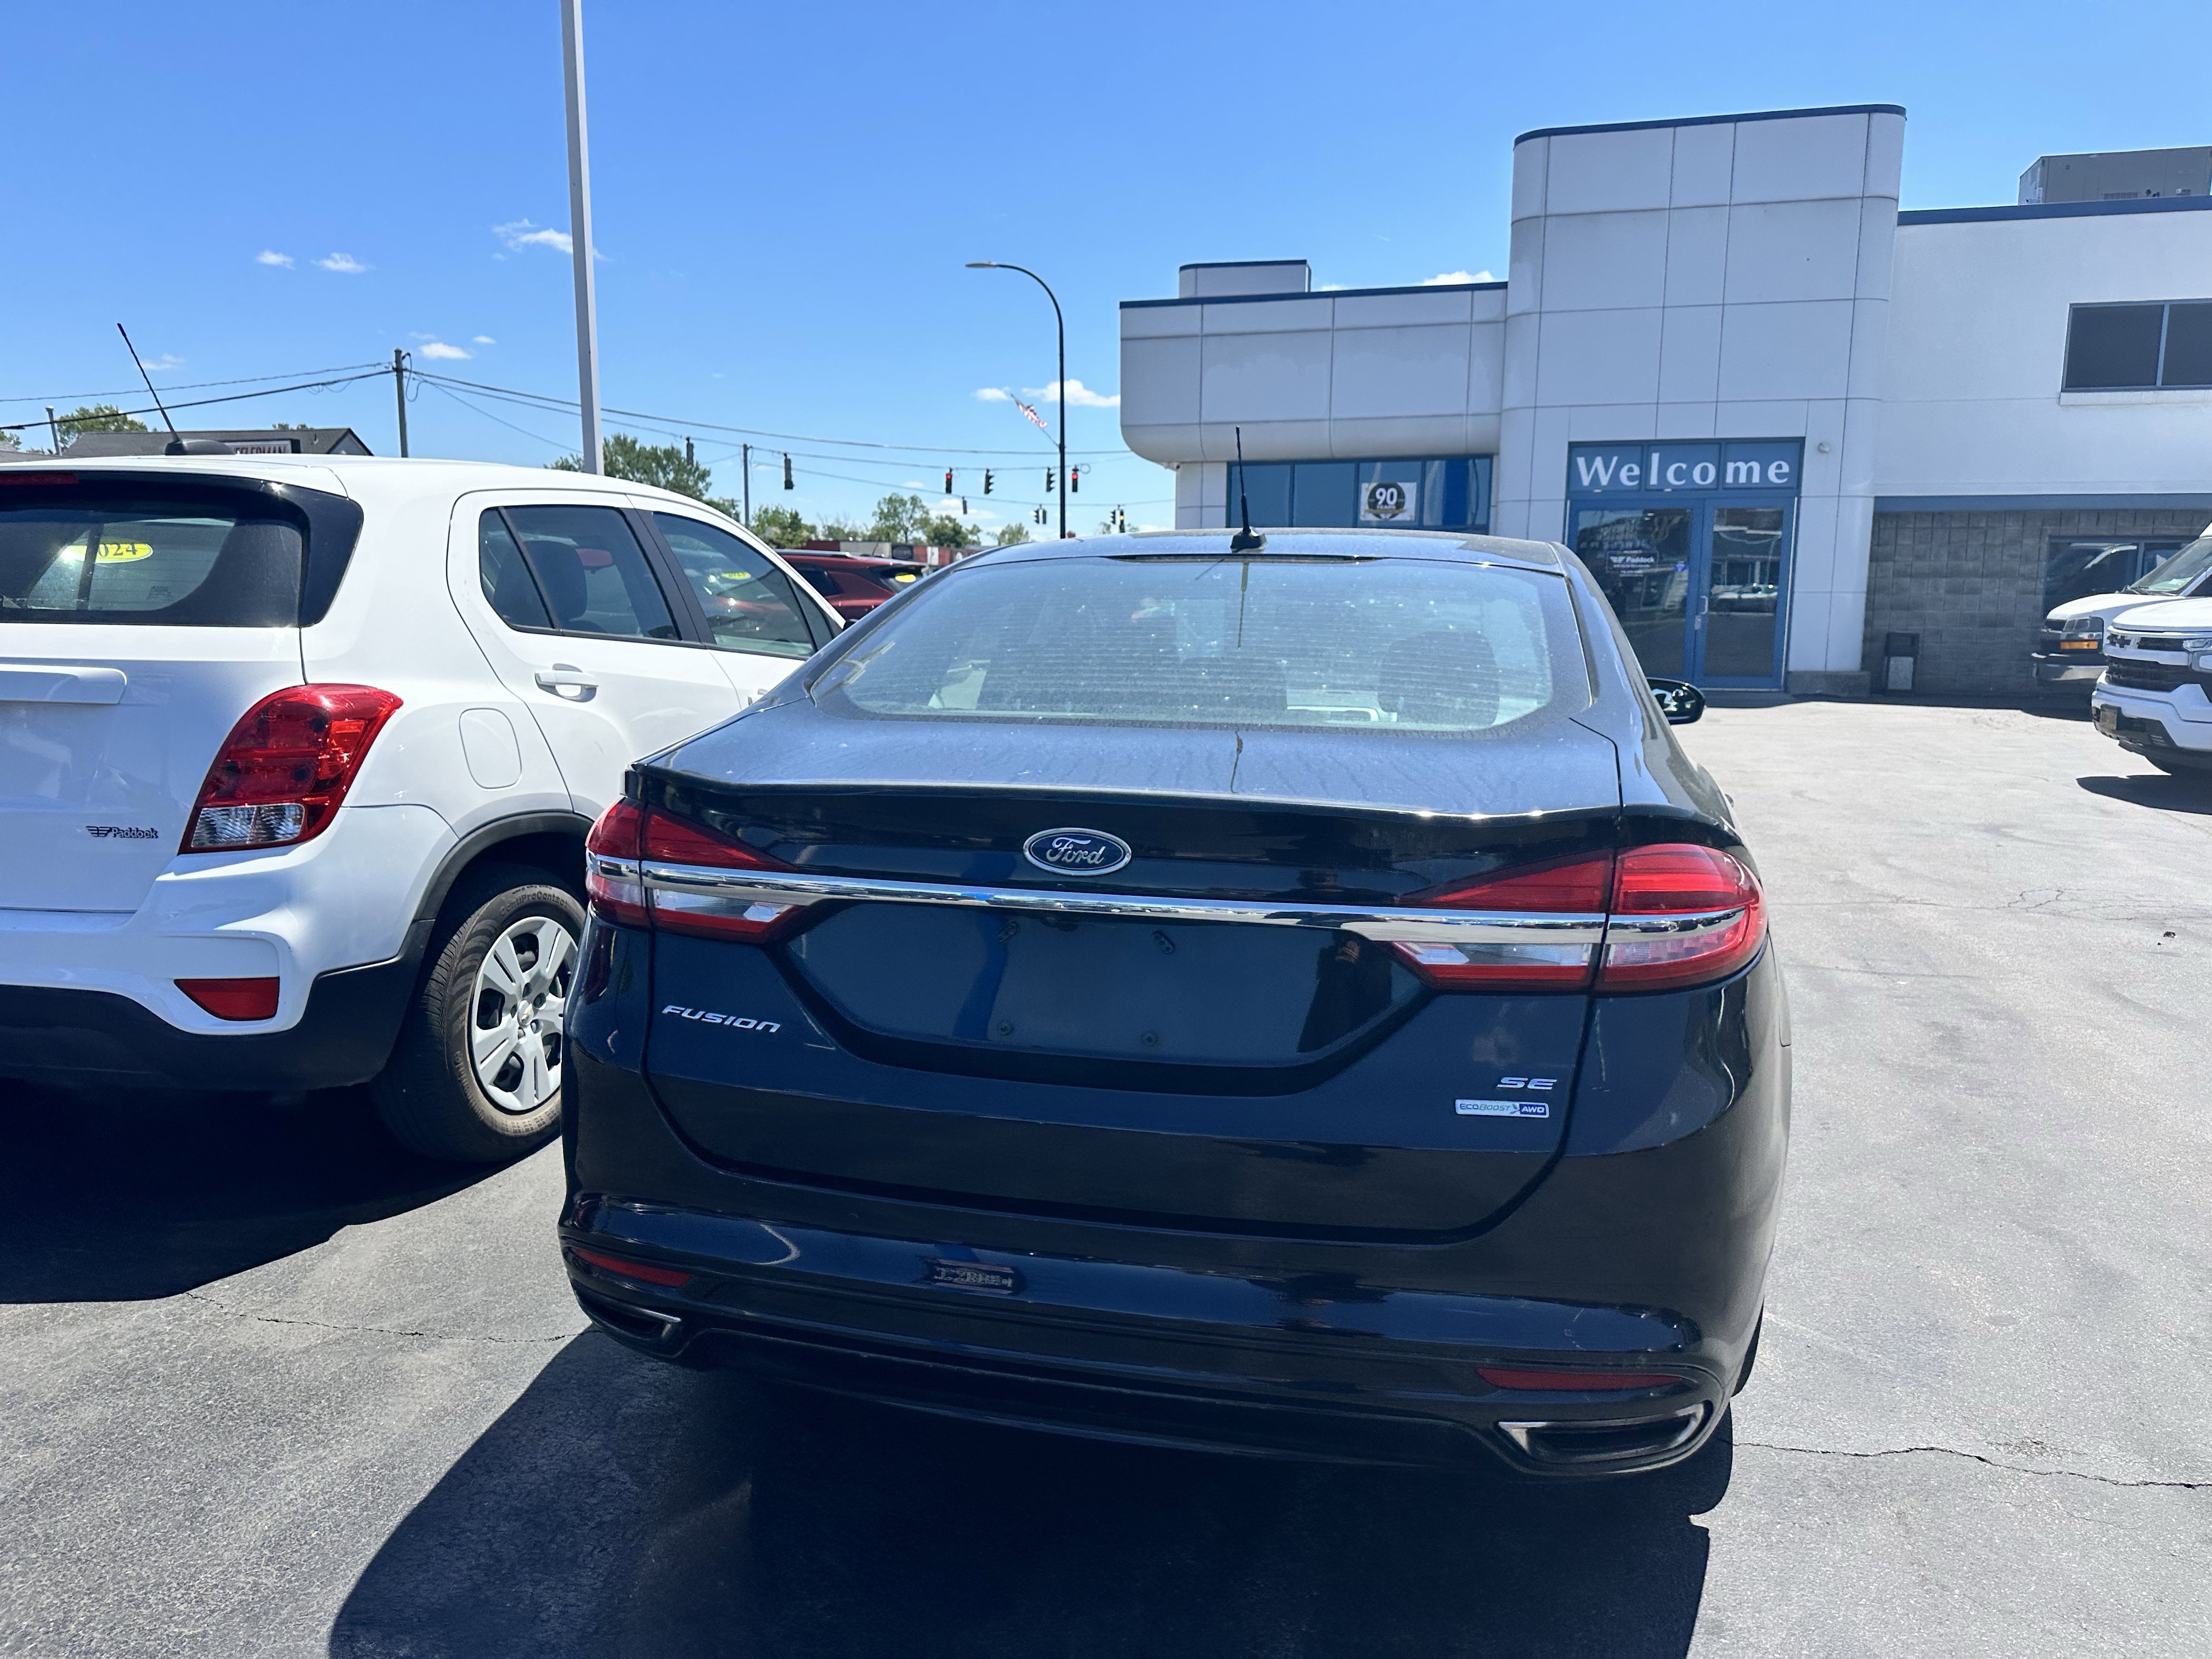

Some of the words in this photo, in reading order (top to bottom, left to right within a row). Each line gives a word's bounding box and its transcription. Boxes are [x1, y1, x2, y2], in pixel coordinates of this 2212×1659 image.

[1576, 452, 1790, 487] Welcome
[1375, 487, 1398, 505] 90
[97, 542, 137, 557] 024
[111, 827, 159, 839] Paddock
[1046, 837, 1106, 865] Ford
[662, 1005, 781, 1033] FUSION
[1497, 1077, 1557, 1090] SE
[1521, 1105, 1545, 1114] AWD
